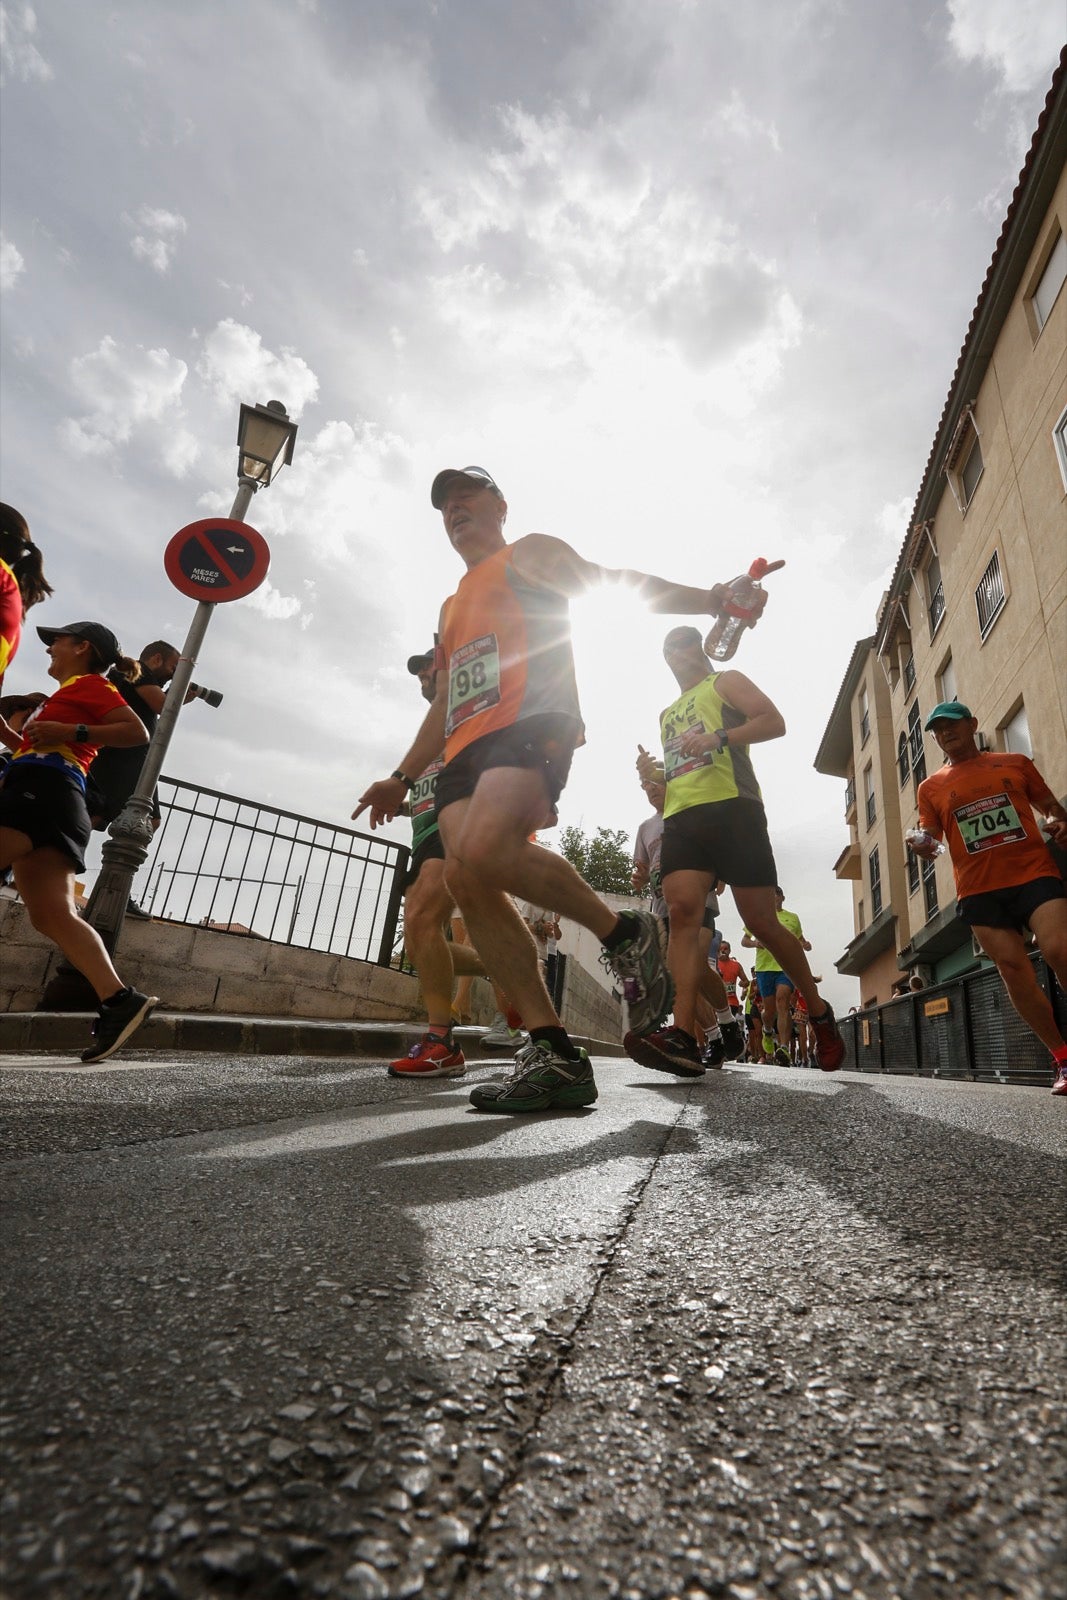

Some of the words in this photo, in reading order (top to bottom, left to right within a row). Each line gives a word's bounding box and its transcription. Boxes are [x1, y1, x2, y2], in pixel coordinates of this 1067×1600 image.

[190, 573, 216, 584] PARES
[192, 567, 219, 578] MESES
[451, 661, 487, 705] 98
[968, 810, 1010, 836] 704
